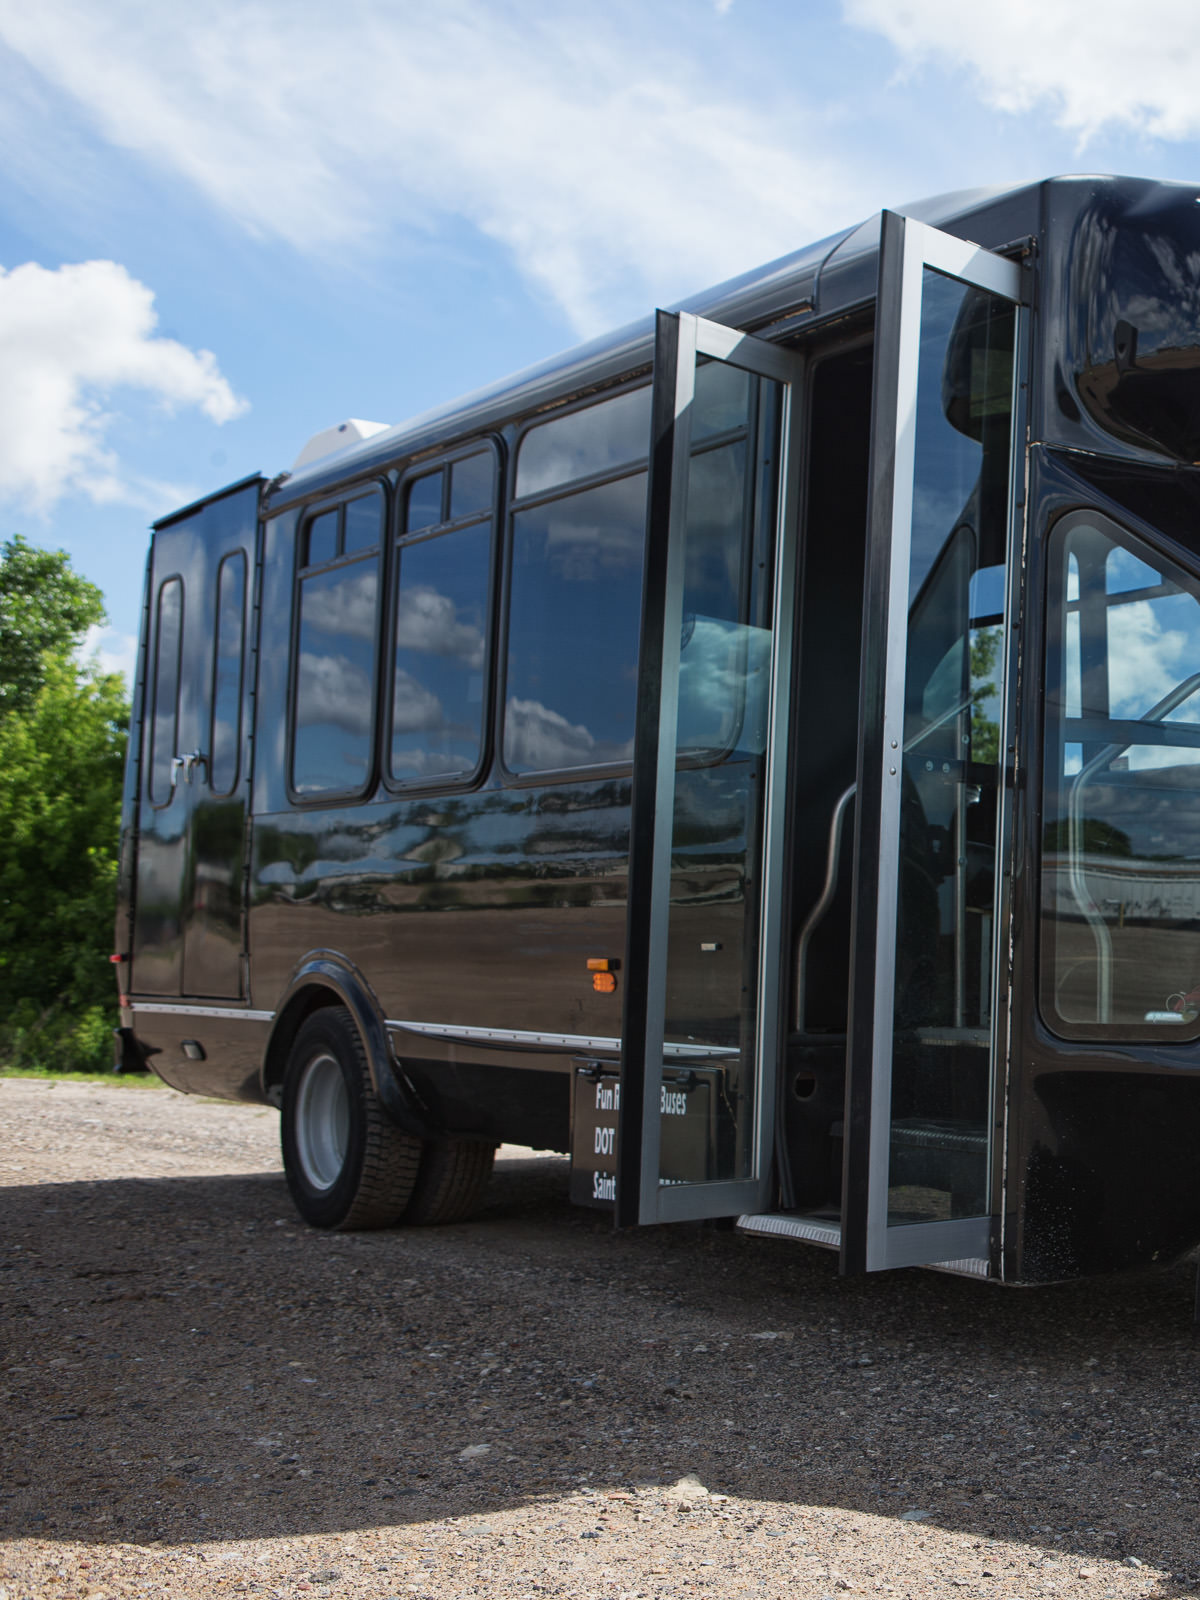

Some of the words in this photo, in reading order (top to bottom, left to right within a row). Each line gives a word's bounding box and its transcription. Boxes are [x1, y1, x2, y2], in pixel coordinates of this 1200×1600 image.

[595, 1083, 612, 1110] Fun
[595, 1127, 615, 1154] DOT
[593, 1171, 616, 1200] Saint
